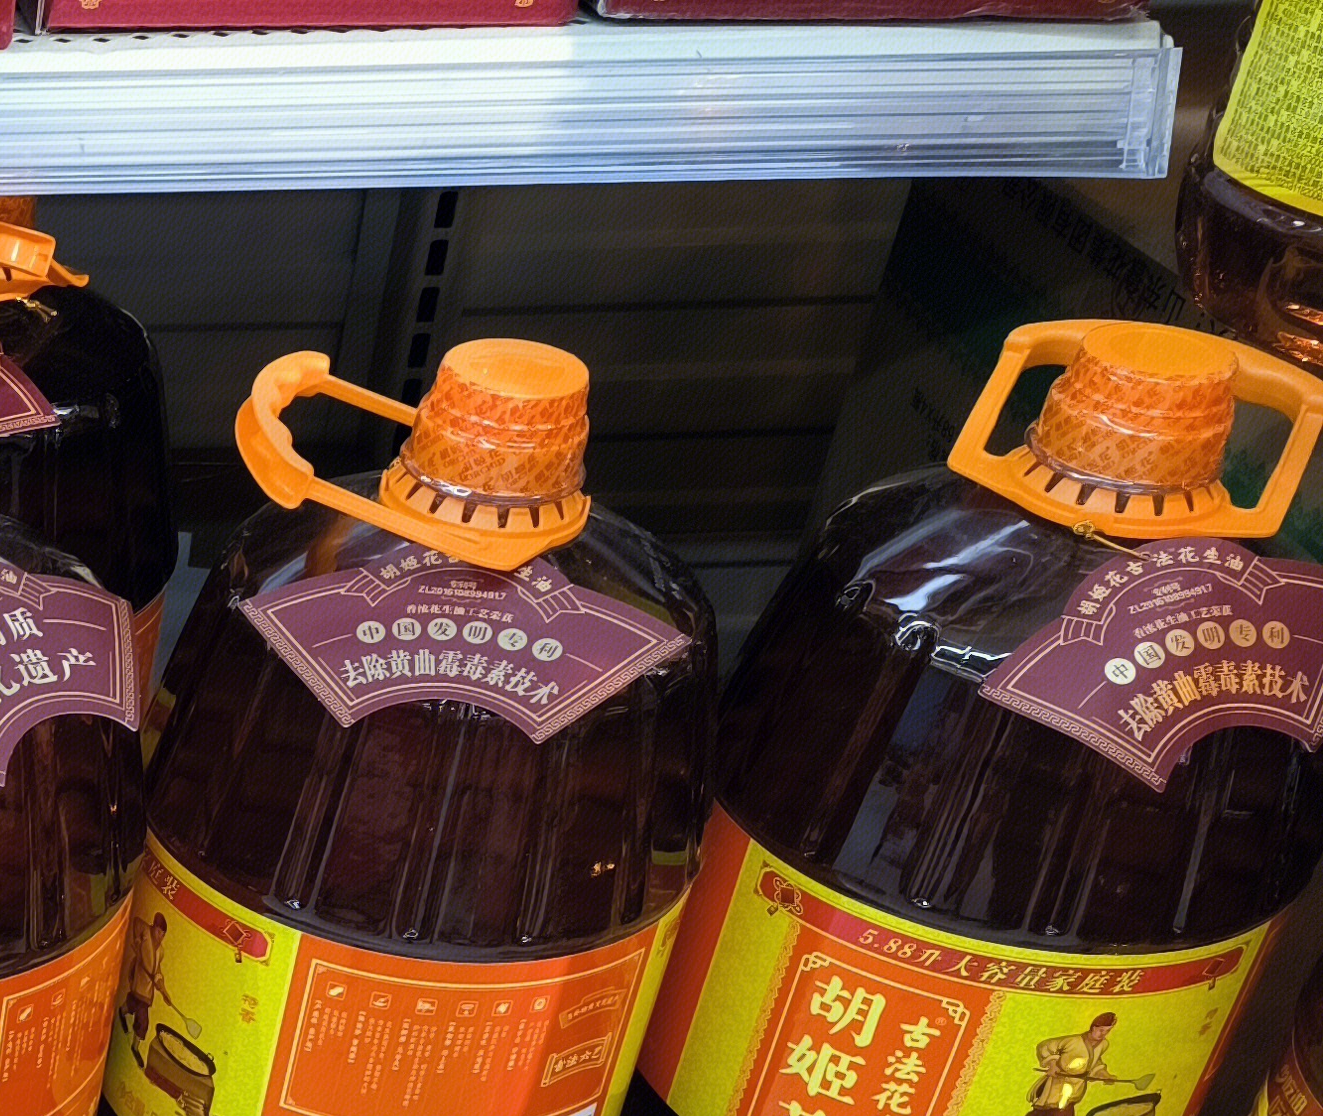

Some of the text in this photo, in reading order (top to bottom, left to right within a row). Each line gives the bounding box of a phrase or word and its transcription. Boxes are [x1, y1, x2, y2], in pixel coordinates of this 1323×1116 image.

[1076, 545, 1245, 616] 胡姬花古法花生油
[356, 617, 564, 662] 中国发明专利
[1105, 619, 1291, 686] 中国发明专利
[339, 647, 561, 707] 去除黄曲霉毒素技术
[1116, 658, 1310, 743] 去除黄曲霉毒素技术
